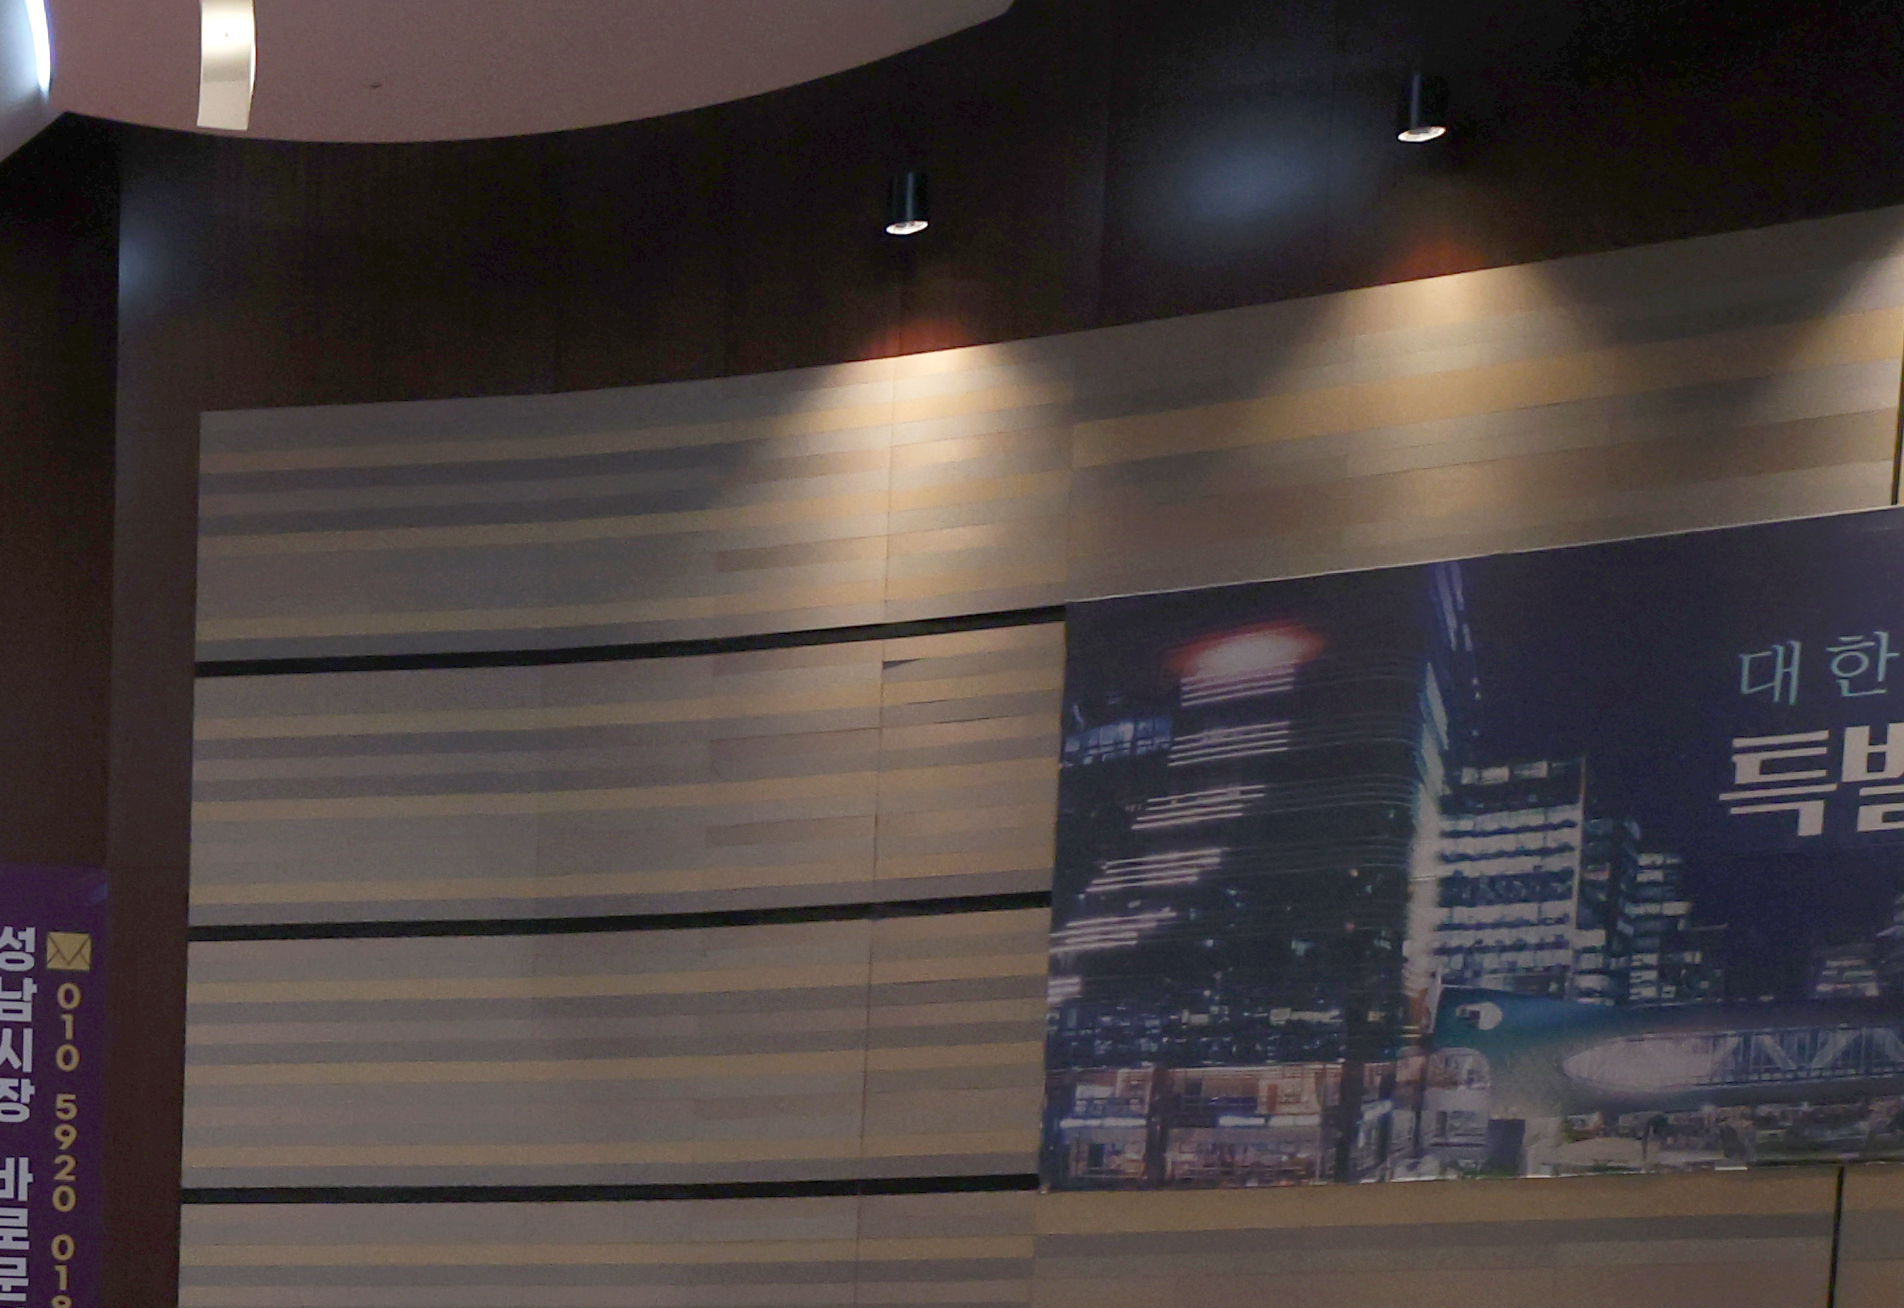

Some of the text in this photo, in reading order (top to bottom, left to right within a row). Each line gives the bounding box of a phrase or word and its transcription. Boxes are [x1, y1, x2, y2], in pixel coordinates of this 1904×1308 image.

[1739, 631, 1900, 706] 대한
[56, 983, 80, 1071] 010
[52, 1094, 77, 1212] 5920
